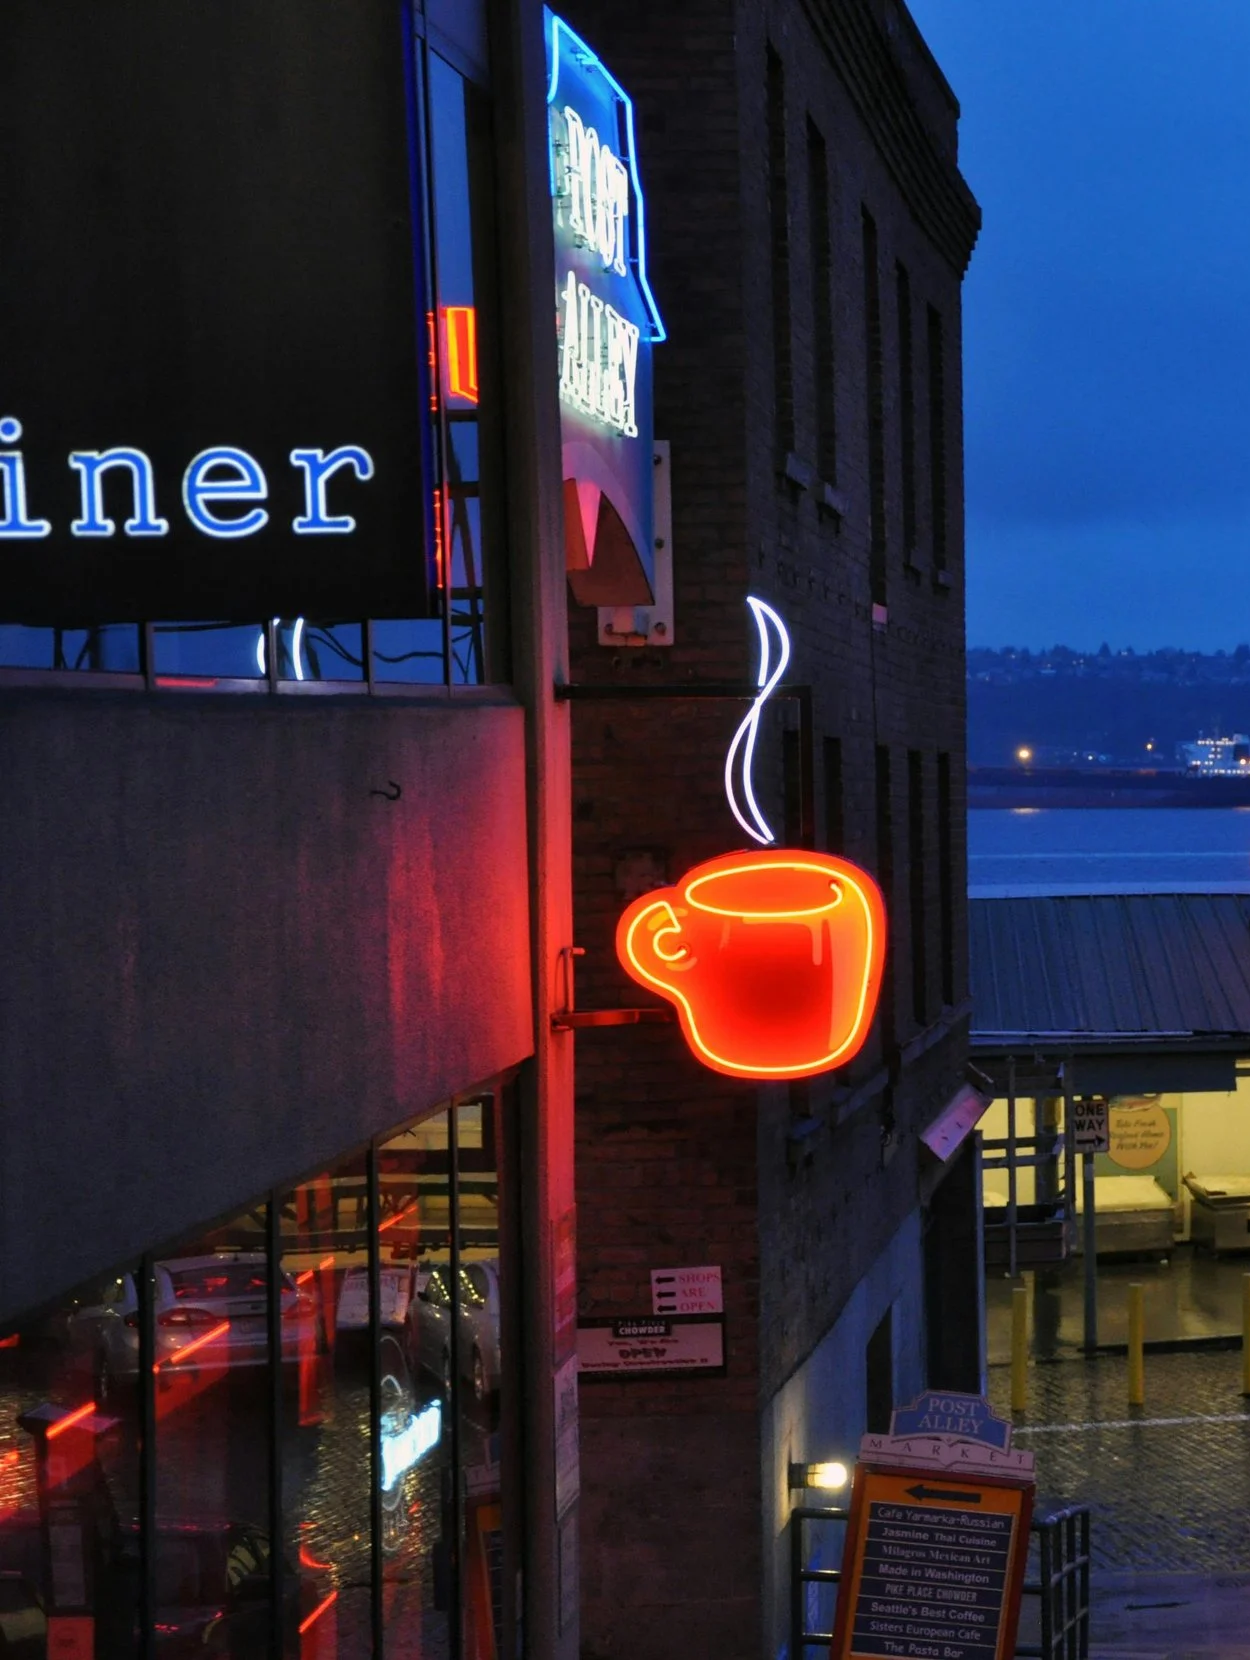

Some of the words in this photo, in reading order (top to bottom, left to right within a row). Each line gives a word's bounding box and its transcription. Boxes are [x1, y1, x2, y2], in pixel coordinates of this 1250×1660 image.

[564, 105, 628, 277] POST
[560, 271, 639, 437] ALLEY
[1075, 1103, 1104, 1116] ONE
[1075, 1119, 1105, 1131] WAY
[679, 1272, 720, 1284] SHOPS
[682, 1287, 706, 1298] ARE
[680, 1301, 716, 1312] OPEN
[619, 1326, 665, 1336] CHOWDER
[619, 1347, 667, 1359] OPEN
[928, 1398, 980, 1416] POST
[918, 1414, 984, 1434] ALLEY
[870, 1439, 1025, 1465] MARKET
[878, 1507, 902, 1520] Cafe
[882, 1528, 929, 1541] Jasmine
[934, 1532, 956, 1542] Thai
[959, 1535, 997, 1547] Cuisine
[929, 1550, 971, 1563] Mexican
[975, 1555, 991, 1565] Art
[879, 1564, 908, 1576] Made
[911, 1566, 921, 1577] in
[924, 1568, 989, 1584] Washington
[885, 1584, 904, 1595] PIKE
[907, 1586, 933, 1598] PLACE
[936, 1588, 977, 1602] CHOWDER
[871, 1602, 918, 1616] Seattle's
[921, 1606, 946, 1618] Best
[948, 1610, 985, 1622] Coffee
[869, 1621, 903, 1633] Sisters
[906, 1624, 955, 1638] European
[957, 1629, 981, 1640] Cafe
[883, 1641, 905, 1653] The
[908, 1643, 939, 1656] Pasta
[944, 1646, 964, 1658] Bar
